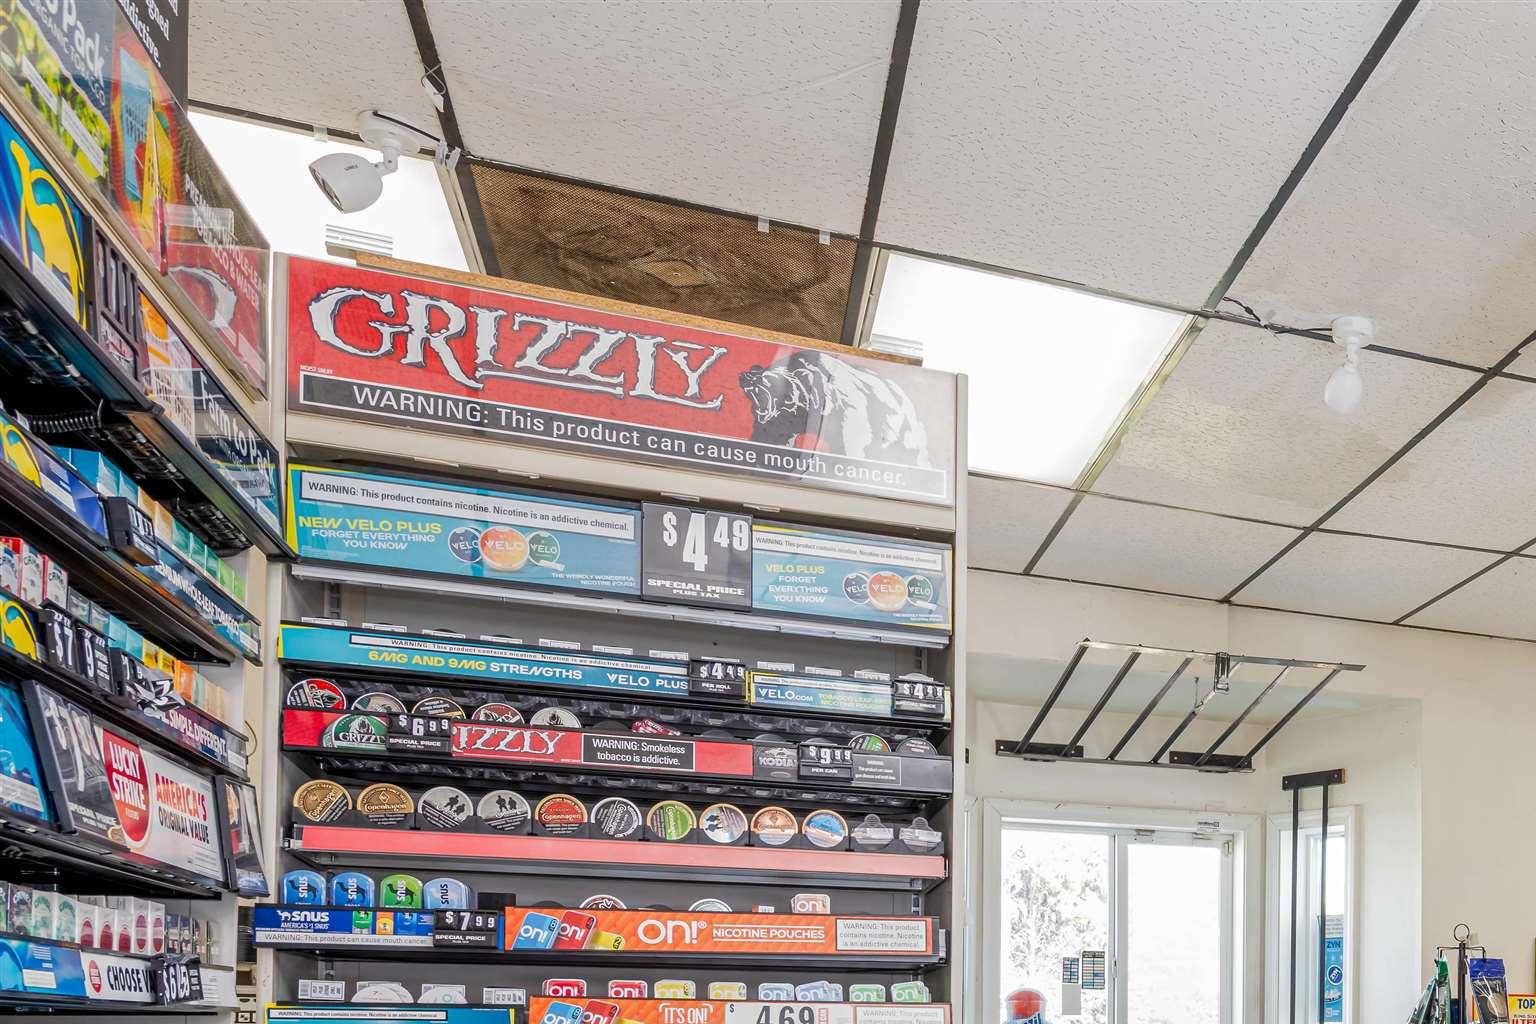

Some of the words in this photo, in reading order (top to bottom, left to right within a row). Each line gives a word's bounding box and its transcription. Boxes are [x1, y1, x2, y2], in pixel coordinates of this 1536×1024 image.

[308, 286, 728, 412] GRIZZLY
[353, 385, 489, 423] WARNING:
[496, 408, 544, 431] This
[552, 420, 641, 447] product
[648, 431, 687, 453] can
[695, 441, 758, 463] cause
[764, 449, 827, 474] mouth
[835, 461, 907, 487] cancer.
[308, 481, 359, 497] WARNING:
[360, 489, 379, 500] This
[380, 491, 415, 505] product
[416, 497, 453, 509] contains
[454, 501, 491, 515] nicotine.
[493, 505, 529, 518] Nicotine
[539, 513, 550, 521] an
[551, 513, 588, 527] addictive
[590, 517, 630, 532] chemical.
[299, 516, 343, 529] NEW
[346, 518, 392, 532] VELO
[396, 521, 443, 534] PLUS
[311, 529, 359, 539] FORGET
[361, 531, 436, 543] EVERYTHING
[343, 539, 368, 549] YOU
[370, 540, 408, 550] KNOW
[484, 539, 525, 552] VELO
[796, 565, 824, 574] PLUS
[647, 578, 703, 591] SPECIAL
[707, 585, 745, 596] PRICE
[778, 575, 817, 584] FORGET
[768, 584, 828, 595] EVERYTHING
[773, 594, 792, 603] YOU
[794, 595, 826, 604] KNOW
[368, 650, 408, 664] 6MG
[411, 654, 445, 666] AND
[448, 656, 487, 671] 9MG
[490, 663, 583, 680] STRENGTHS
[655, 679, 688, 690] PLUS
[389, 738, 418, 747] SPECIAL
[592, 738, 640, 752] WARNING:
[641, 743, 685, 754] Smokeless
[109, 740, 140, 779] LUCKY
[597, 751, 631, 762] tobacco
[633, 753, 640, 763] is
[642, 754, 681, 766] addictive.
[112, 772, 146, 811] STRIKE
[154, 772, 208, 822] AMERICA'S
[364, 802, 407, 813] Copenhagen
[541, 812, 581, 821] Copenhagen
[159, 809, 189, 837] ORIGINAL
[189, 819, 210, 845] VALUE
[712, 928, 767, 939] NICOTINE
[769, 929, 825, 940] POUCHES
[107, 964, 142, 993] CHOOSE
[1518, 999, 1536, 1009] TOP
[664, 1007, 687, 1024] IT'S
[689, 1007, 708, 1024] ON!
